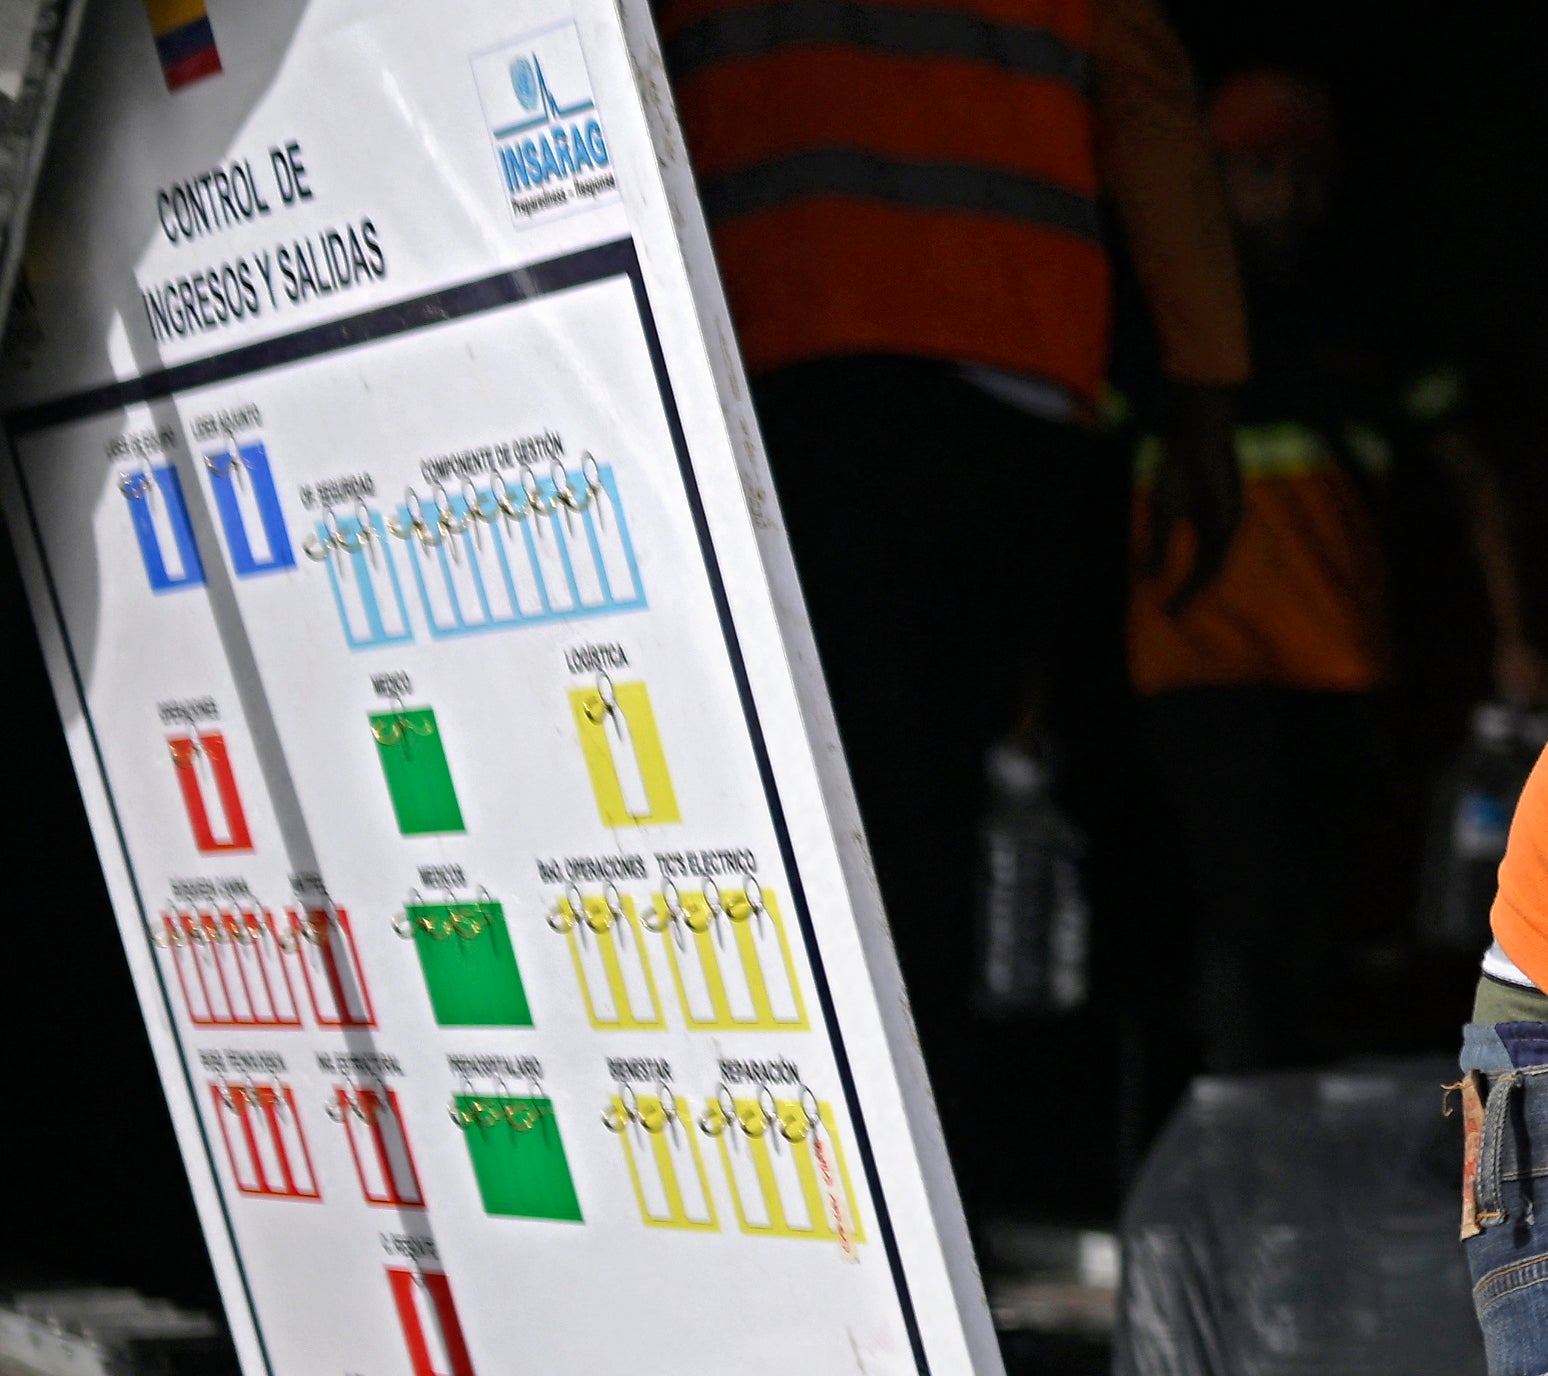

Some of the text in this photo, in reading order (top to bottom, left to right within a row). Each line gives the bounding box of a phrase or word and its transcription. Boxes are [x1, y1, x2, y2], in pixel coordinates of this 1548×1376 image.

[499, 119, 609, 193] INSARAG
[156, 140, 312, 244] CONTROL DE
[510, 186, 567, 217] Preparedness
[573, 173, 616, 201] Response
[142, 216, 386, 341] INGRESOS Y SALIDAS
[420, 445, 496, 485] COMPONENTE
[494, 441, 514, 470] DE
[564, 636, 629, 673] LOGÍSTICA
[565, 855, 648, 882] OPERACIONES
[656, 852, 689, 879] TIC'S
[607, 1056, 674, 1084] BIENESTAR
